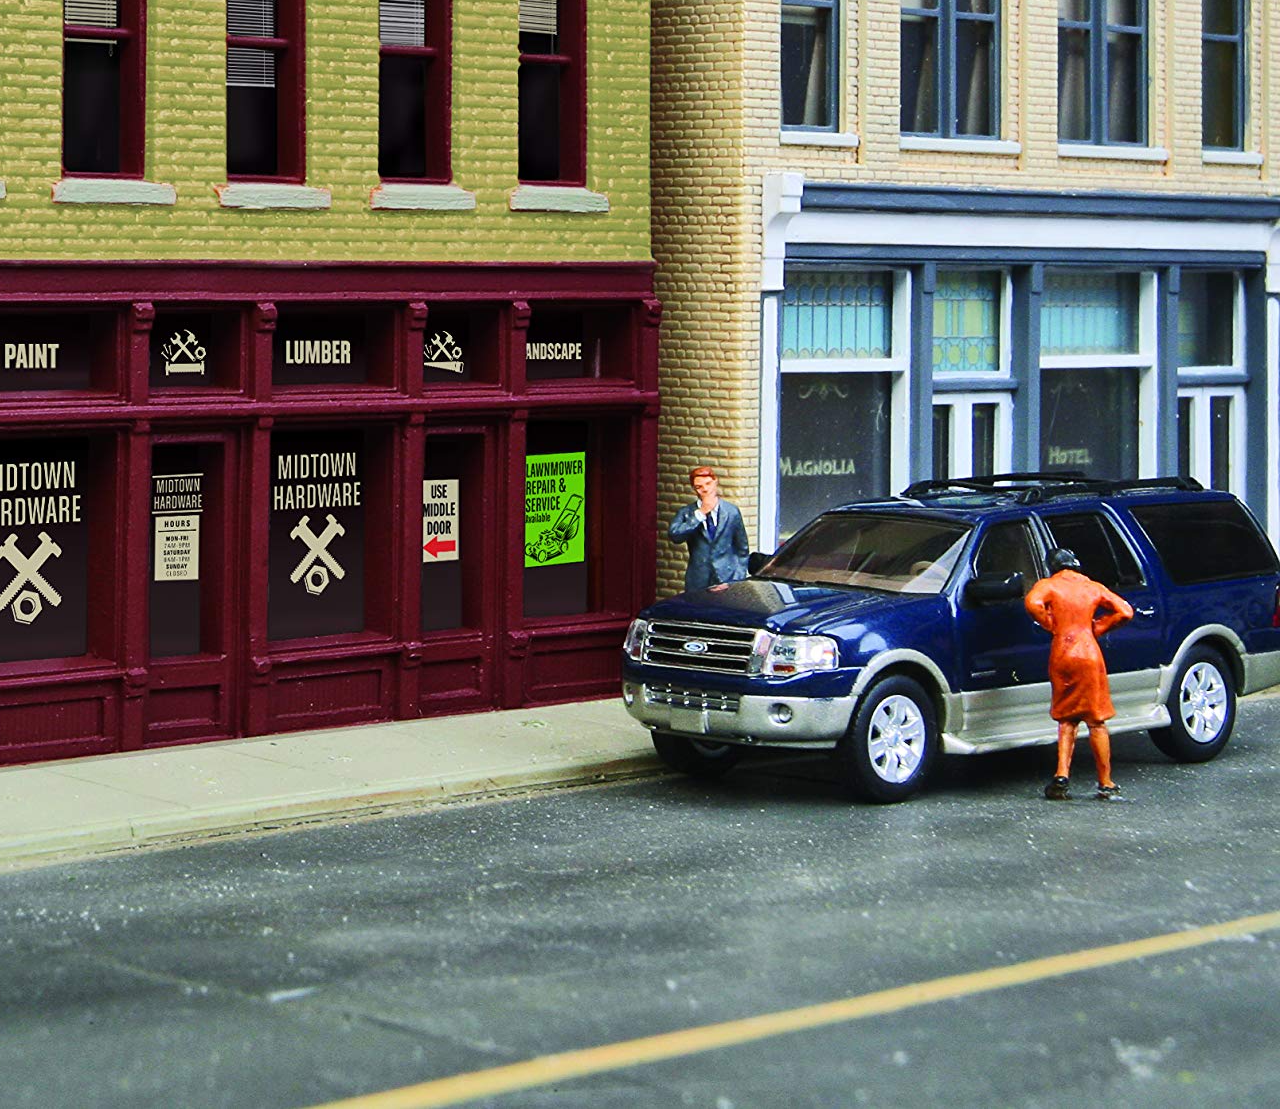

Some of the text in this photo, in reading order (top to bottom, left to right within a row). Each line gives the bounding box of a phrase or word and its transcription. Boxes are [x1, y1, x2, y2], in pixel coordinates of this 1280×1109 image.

[4, 343, 60, 369] PAINT
[285, 339, 351, 364] LUMBER
[525, 342, 582, 360] ANDSCAPE
[278, 452, 357, 480] MIDTOWN
[526, 460, 583, 478] LAWNMOWER
[779, 456, 856, 477] MAGNOLIA
[156, 478, 200, 494] MIDTOWN
[431, 484, 447, 499] USE
[526, 477, 566, 495] REPAIR &
[154, 494, 202, 509] HARDWARE
[273, 481, 361, 510] HARDWARE
[525, 496, 560, 512] SERVICE
[422, 502, 455, 517] MIDDLE
[164, 519, 191, 528] HOURS
[427, 520, 451, 535] DOOR
